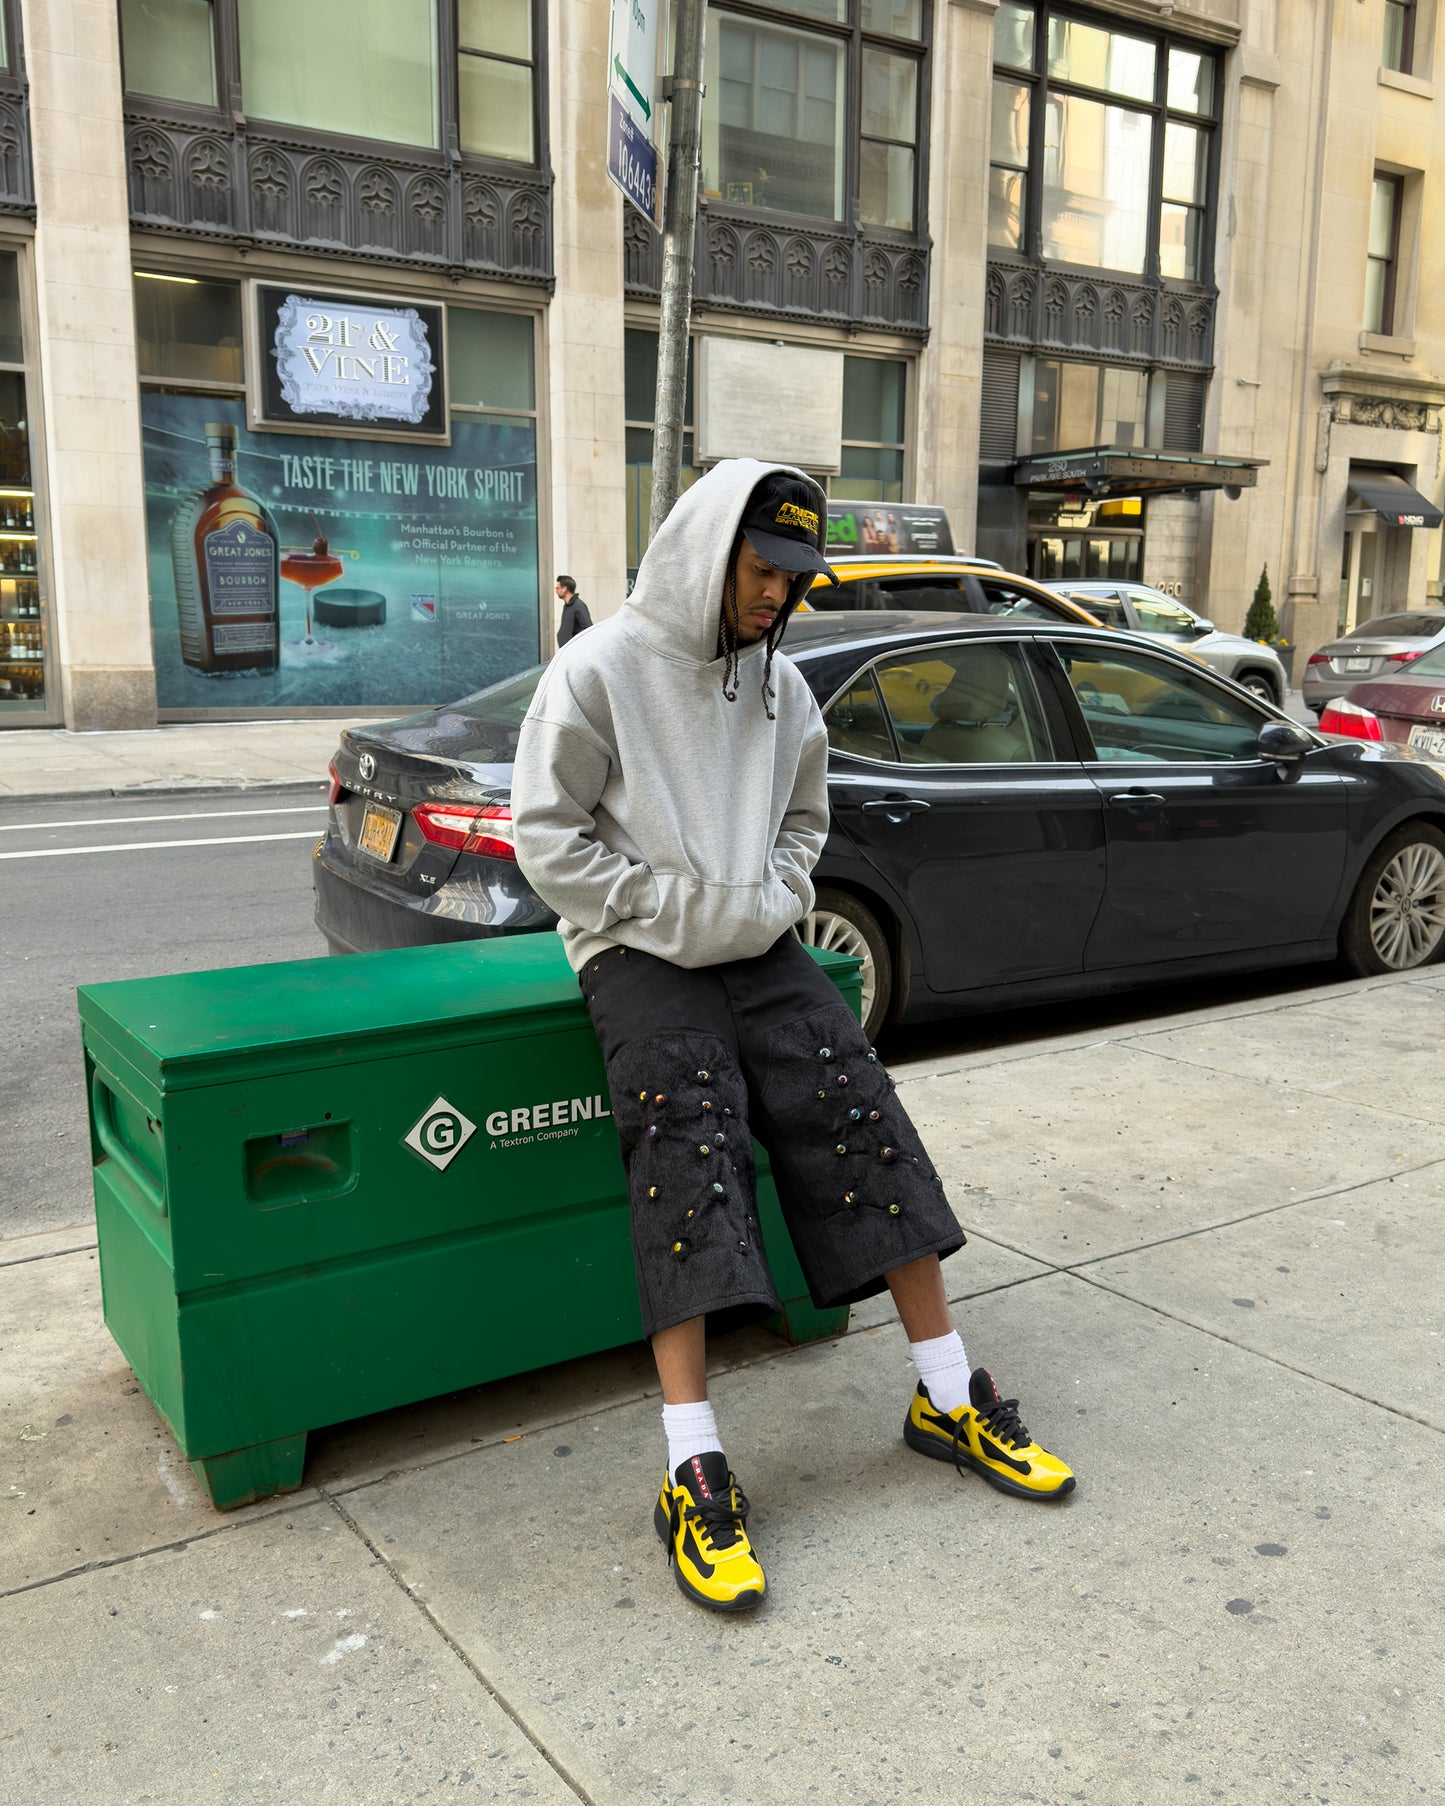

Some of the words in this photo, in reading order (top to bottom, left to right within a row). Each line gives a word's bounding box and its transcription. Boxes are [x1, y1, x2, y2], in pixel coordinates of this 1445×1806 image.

[618, 139, 651, 210] 106443
[368, 320, 401, 352] &
[296, 345, 410, 386] VINE
[279, 453, 335, 490] TASTE
[341, 459, 374, 493] THE
[380, 461, 419, 496] NEW
[425, 464, 470, 500] YORK
[474, 468, 524, 503] SPIRIT
[1062, 469, 1087, 479] SOUTH
[400, 523, 461, 536] Manhattan's
[463, 526, 504, 538] Bourbon
[506, 529, 514, 539] is
[209, 547, 241, 556] GREAT
[244, 547, 272, 557] JONES
[412, 538, 448, 550] Official
[450, 540, 487, 552] Partner
[489, 541, 500, 552] of
[501, 543, 518, 554] the
[415, 553, 437, 564] New
[440, 554, 462, 565] York
[219, 576, 267, 586] BOURBON
[455, 611, 482, 620] GREAT
[485, 611, 511, 620] JONES
[345, 780, 397, 802] CAMRY
[420, 873, 437, 885] XLE
[485, 1094, 614, 1136] GREENL
[489, 1141, 497, 1150] A
[499, 1135, 534, 1149] Textron
[537, 1127, 579, 1142] Company
[693, 1460, 709, 1499] PRADA
